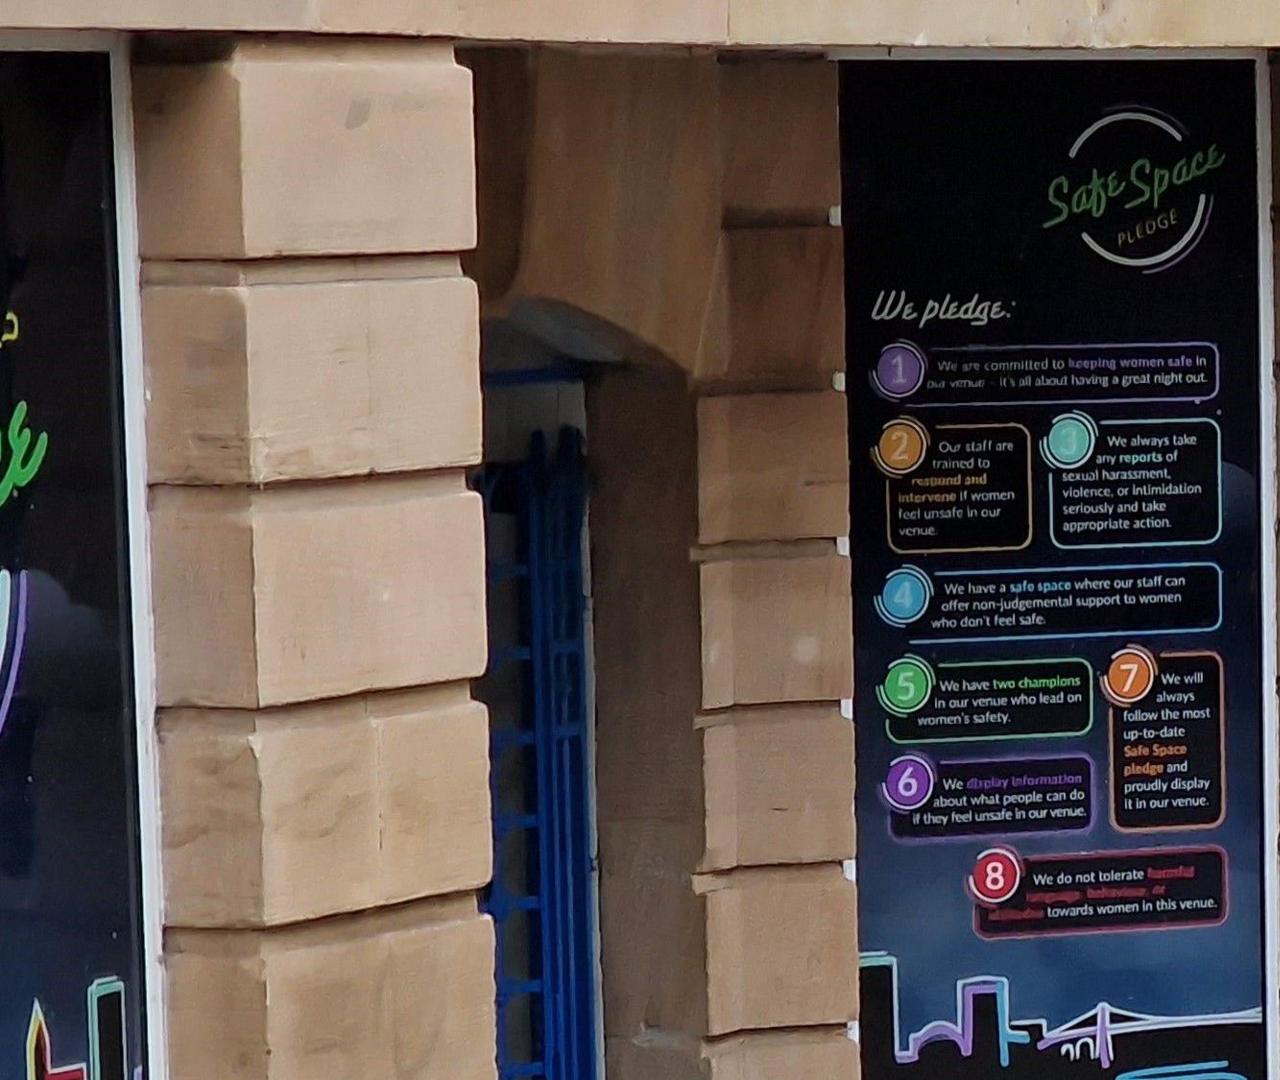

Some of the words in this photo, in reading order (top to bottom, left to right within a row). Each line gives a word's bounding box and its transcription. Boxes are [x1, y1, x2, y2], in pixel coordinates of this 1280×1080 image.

[1043, 169, 1126, 228] Safe
[1126, 144, 1225, 208] Space
[1118, 209, 1178, 247] PLEDGE
[872, 290, 917, 320] We
[984, 357, 1048, 372] committed
[1052, 359, 1064, 370] to
[1120, 358, 1164, 368] women
[1168, 355, 1192, 368] safe
[1196, 356, 1207, 367] in
[1112, 376, 1119, 385] a
[1122, 373, 1150, 388] great
[1154, 372, 1182, 386] night
[891, 432, 909, 460] 2
[939, 441, 960, 452] Our
[966, 440, 992, 452] staff
[996, 442, 1013, 451] are
[1107, 436, 1126, 447] We
[1131, 434, 1169, 448] always
[1173, 434, 1197, 445] take
[933, 458, 974, 469] trained
[978, 458, 990, 468] to
[1096, 455, 1115, 465] any
[1119, 452, 1162, 465] reports
[1166, 450, 1178, 462] of
[1062, 469, 1098, 482] sexual
[960, 490, 967, 501] if
[971, 491, 1015, 500] women
[1117, 487, 1128, 496] or
[924, 507, 963, 519] unsafe
[967, 507, 977, 518] in
[981, 508, 1001, 517] our
[1063, 501, 1113, 515] seriously
[1117, 501, 1138, 513] and
[1142, 500, 1166, 512] take
[1063, 518, 1130, 533] appropriate
[944, 583, 964, 595] We
[968, 582, 995, 594] have
[999, 584, 1006, 593] a
[1074, 578, 1110, 590] where
[1114, 578, 1133, 588] our
[1137, 576, 1162, 588] staff
[1165, 577, 1185, 587] can
[941, 600, 969, 612] offer
[1076, 594, 1121, 608] support
[1124, 593, 1135, 603] to
[1139, 593, 1181, 603] women
[931, 617, 957, 628] who
[939, 681, 959, 692] We
[963, 679, 990, 690] have
[993, 678, 1015, 688] two
[1018, 675, 1080, 690] champions
[1120, 664, 1138, 692] 7
[1161, 673, 1180, 685] We
[1184, 672, 1203, 684] will
[898, 672, 914, 700] 5
[935, 698, 945, 708] in
[949, 698, 968, 708] our
[973, 697, 1007, 707] venue
[1011, 695, 1036, 706] who
[1039, 692, 1063, 704] lead
[1067, 694, 1082, 702] on
[1156, 690, 1195, 703] always
[918, 713, 969, 726] women's
[973, 712, 1011, 724] safety.
[1123, 710, 1158, 722] follow
[1161, 708, 1179, 720] the
[1182, 707, 1210, 718] most
[1123, 727, 1185, 740] up-to-date
[1124, 745, 1149, 757] Safe
[1153, 743, 1187, 758] Space
[1167, 760, 1188, 772] and
[898, 767, 917, 796] 6
[943, 779, 963, 790] We
[1124, 778, 1168, 794] proudly
[1171, 776, 1210, 791] display
[933, 796, 967, 807] about
[970, 793, 999, 806] what
[1003, 792, 1042, 805] people
[1046, 791, 1066, 801] can
[1069, 789, 1084, 800] do
[1125, 798, 1132, 810] it
[1136, 798, 1146, 809] in
[1150, 798, 1170, 808] our
[1172, 797, 1209, 807] venue.
[913, 812, 920, 824] if
[923, 812, 947, 825] they
[952, 811, 972, 823] feel
[975, 809, 1012, 822] unsafe
[1016, 807, 1025, 819] in
[1028, 807, 1047, 818] our
[1050, 807, 1086, 817] venue.
[986, 862, 1004, 890] 8
[1033, 873, 1054, 886] We
[1057, 872, 1071, 885] do
[1075, 871, 1095, 883] not
[1099, 869, 1144, 882] tolerate
[1047, 903, 1093, 917] towards
[1097, 900, 1139, 914] women
[1143, 899, 1152, 912] in
[1156, 898, 1177, 911] this
[1179, 898, 1217, 910] venue.
